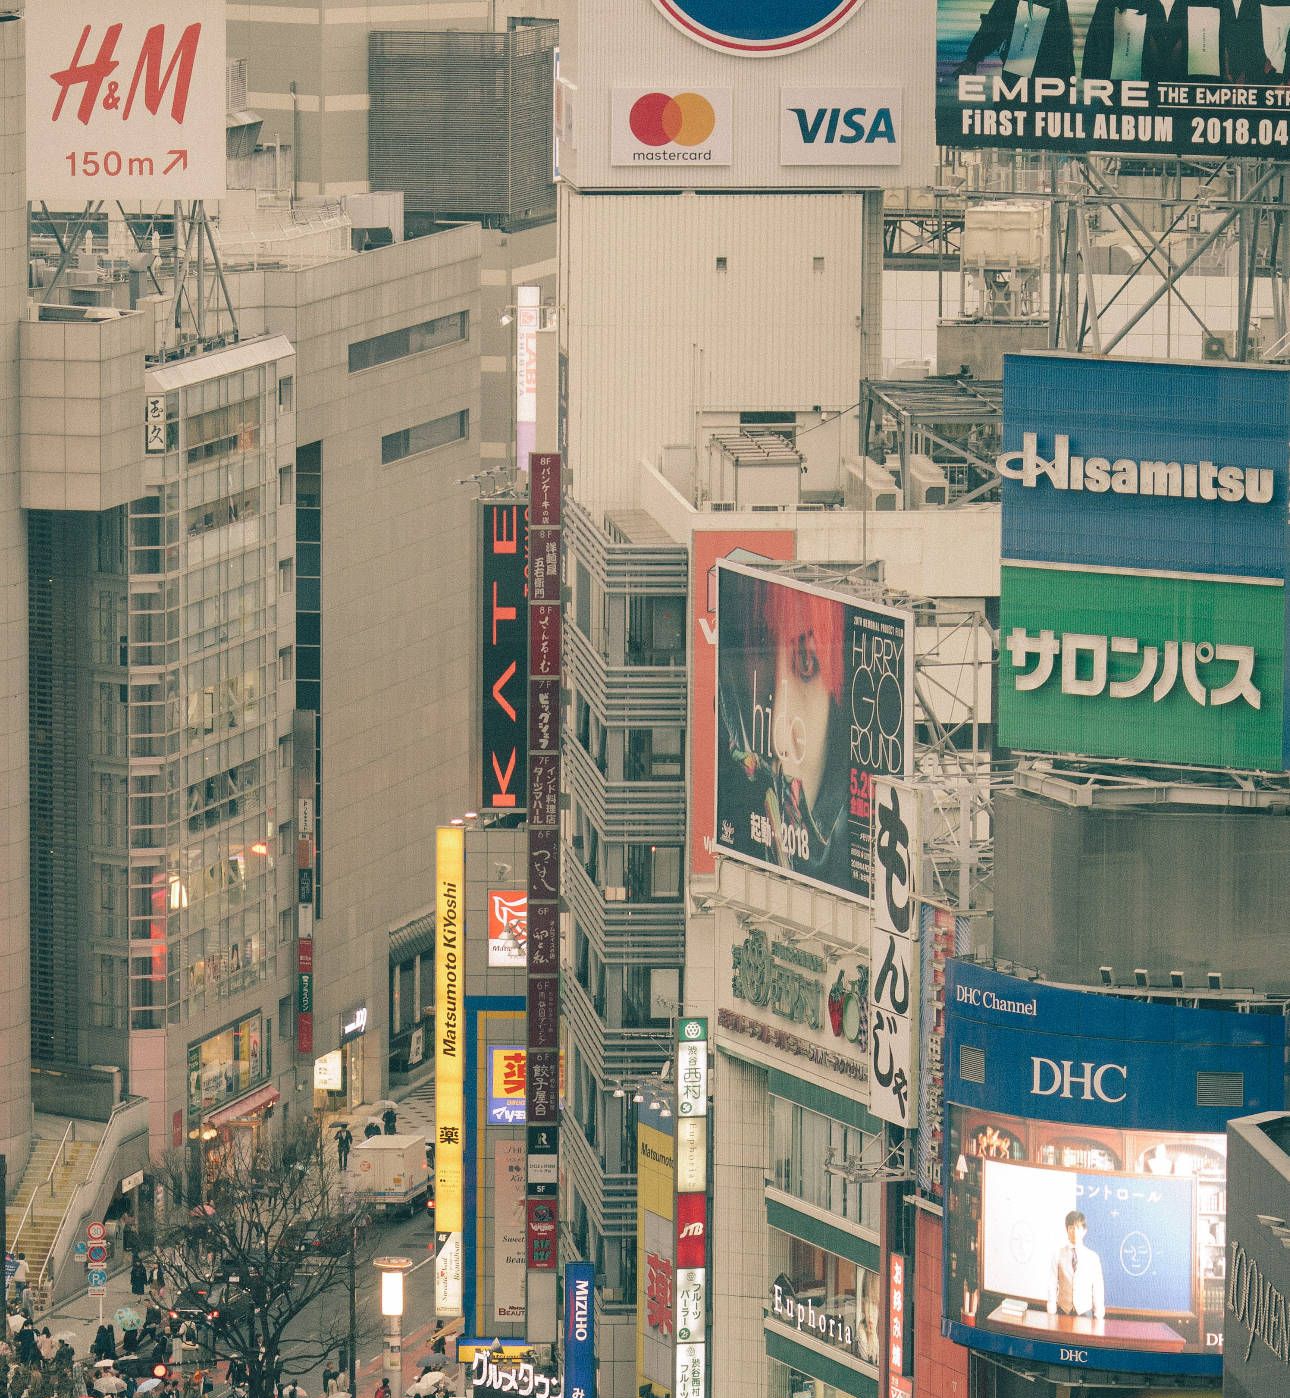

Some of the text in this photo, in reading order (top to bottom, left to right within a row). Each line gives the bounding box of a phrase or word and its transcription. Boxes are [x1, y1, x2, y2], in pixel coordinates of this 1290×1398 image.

[50, 22, 202, 126] H&M
[1158, 87, 1189, 104] THE
[787, 107, 897, 145] VISA
[1035, 112, 1086, 139] FULL
[1093, 114, 1173, 142] ALBUM
[1192, 117, 1290, 146] 2018.04
[65, 151, 155, 177] 150m
[633, 150, 712, 161] mastercard
[996, 431, 1274, 504] Hisamitsu
[493, 505, 516, 807] KATE
[852, 630, 904, 679] HURRY
[1006, 628, 1262, 711] サロンパス
[852, 665, 902, 738] GO
[850, 725, 902, 774] ROUND
[533, 767, 544, 824] タージマハール
[545, 767, 557, 824] インド料理店
[781, 822, 809, 860] 2018
[442, 880, 457, 1058] Matsumoto Kiyoshi
[873, 786, 909, 1120] もんじゃ
[956, 985, 1038, 1016] DHC Channel
[533, 1065, 549, 1117] 餃子屋台
[1030, 1057, 1127, 1103] DHC
[440, 1126, 460, 1144] 薬
[680, 1222, 704, 1239] JTB
[575, 1280, 589, 1341] MIZUHO
[692, 1283, 702, 1320] フルーツ
[774, 1284, 853, 1345] Euphoria
[691, 1358, 701, 1397] 渋谷西村
[1060, 1349, 1088, 1363] DHC
